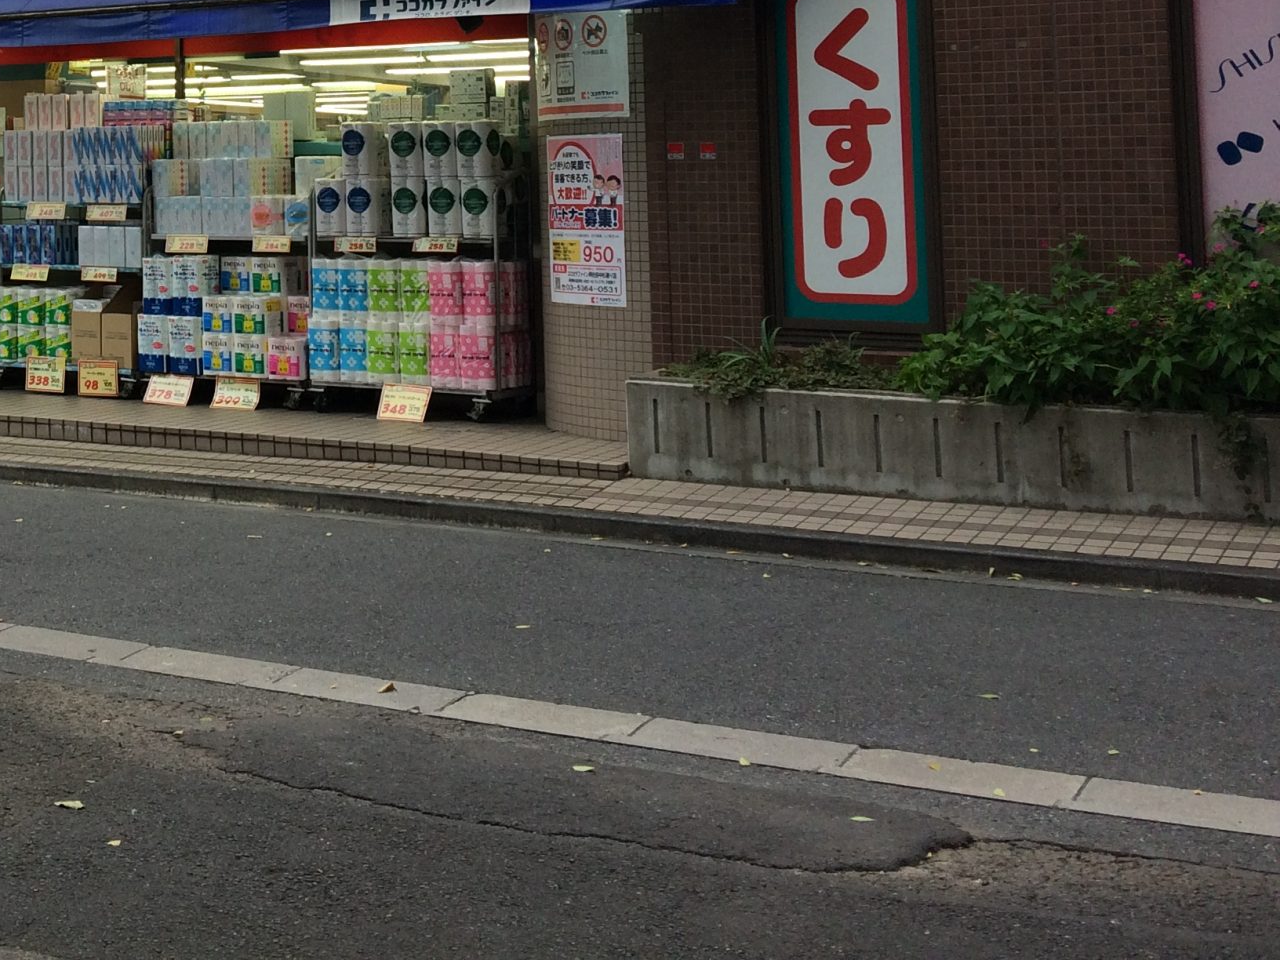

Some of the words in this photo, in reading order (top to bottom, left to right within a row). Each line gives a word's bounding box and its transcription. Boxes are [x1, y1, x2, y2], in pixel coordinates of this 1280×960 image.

[1209, 33, 1280, 93] SHIS
[808, 7, 892, 279] くすり
[583, 246, 614, 263] 950
[224, 261, 246, 269] nepia
[253, 262, 276, 270] nepia
[205, 302, 228, 310] nepia
[237, 303, 260, 311] nepia
[205, 339, 228, 348] nepia
[237, 341, 259, 349] nepia
[271, 343, 295, 351] nepia
[28, 375, 49, 386] 338
[84, 380, 99, 390] 98
[149, 389, 171, 399] 378
[382, 403, 407, 415] 348
